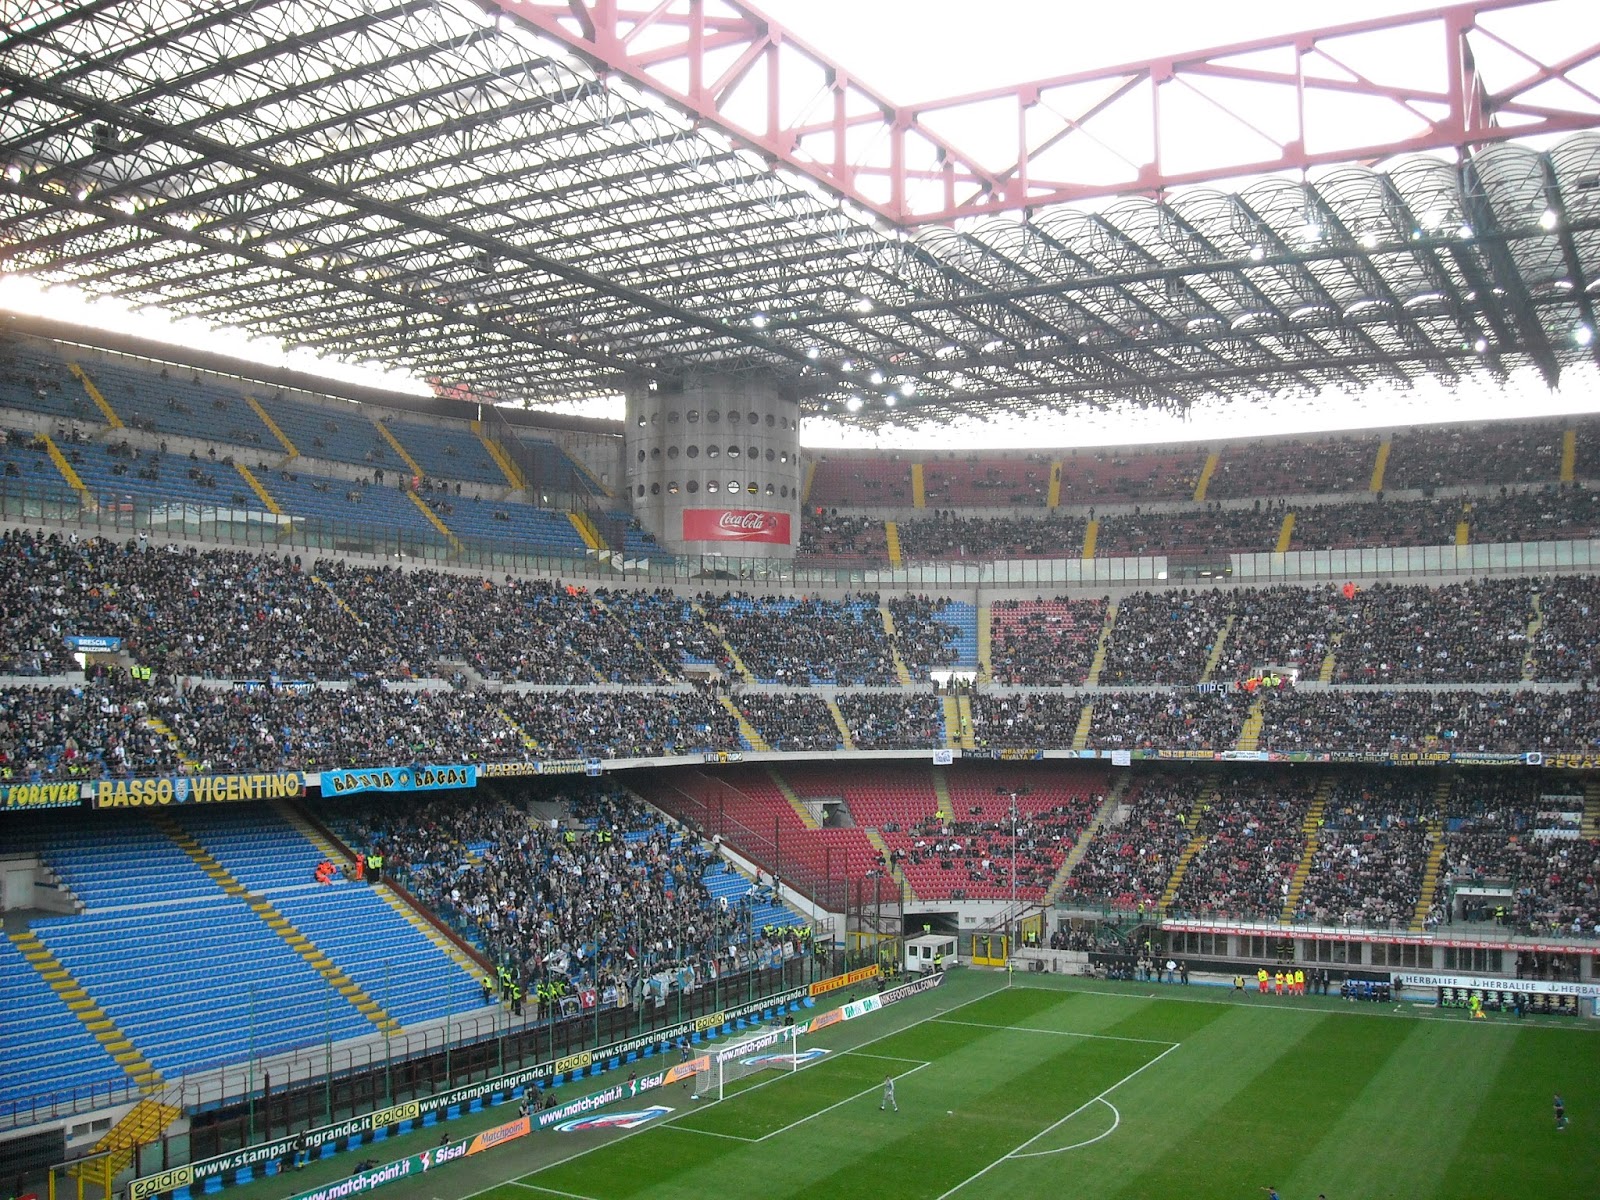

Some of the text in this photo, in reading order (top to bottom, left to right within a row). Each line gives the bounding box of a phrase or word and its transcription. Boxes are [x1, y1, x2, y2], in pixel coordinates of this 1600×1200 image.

[720, 511, 764, 529] Coca-Cola
[486, 762, 535, 773] PADOVA
[7, 783, 78, 806] FOREVER
[99, 773, 299, 808] BASSO VICENTINO
[812, 965, 877, 995] PIRELLI PIRELLI
[880, 978, 936, 1005] NIKEFOOTBALL.COM
[1406, 975, 1458, 986] HERBALIFE
[1482, 980, 1536, 991] HERBALIFE
[725, 988, 808, 1021] www.stampareingrande.it
[592, 1023, 695, 1062] www.stampareingrande.it
[557, 1053, 589, 1072] egidio
[420, 1065, 552, 1112] www.stampareingrande.it
[640, 1073, 663, 1090] Sisal
[374, 1105, 416, 1128] egidio
[539, 1087, 622, 1125] www.match-point.it
[481, 1122, 523, 1144] Matchpoint
[195, 1117, 370, 1178] www.stamparengrande.it
[436, 1142, 466, 1162] Sisal
[135, 1170, 188, 1198] egidio
